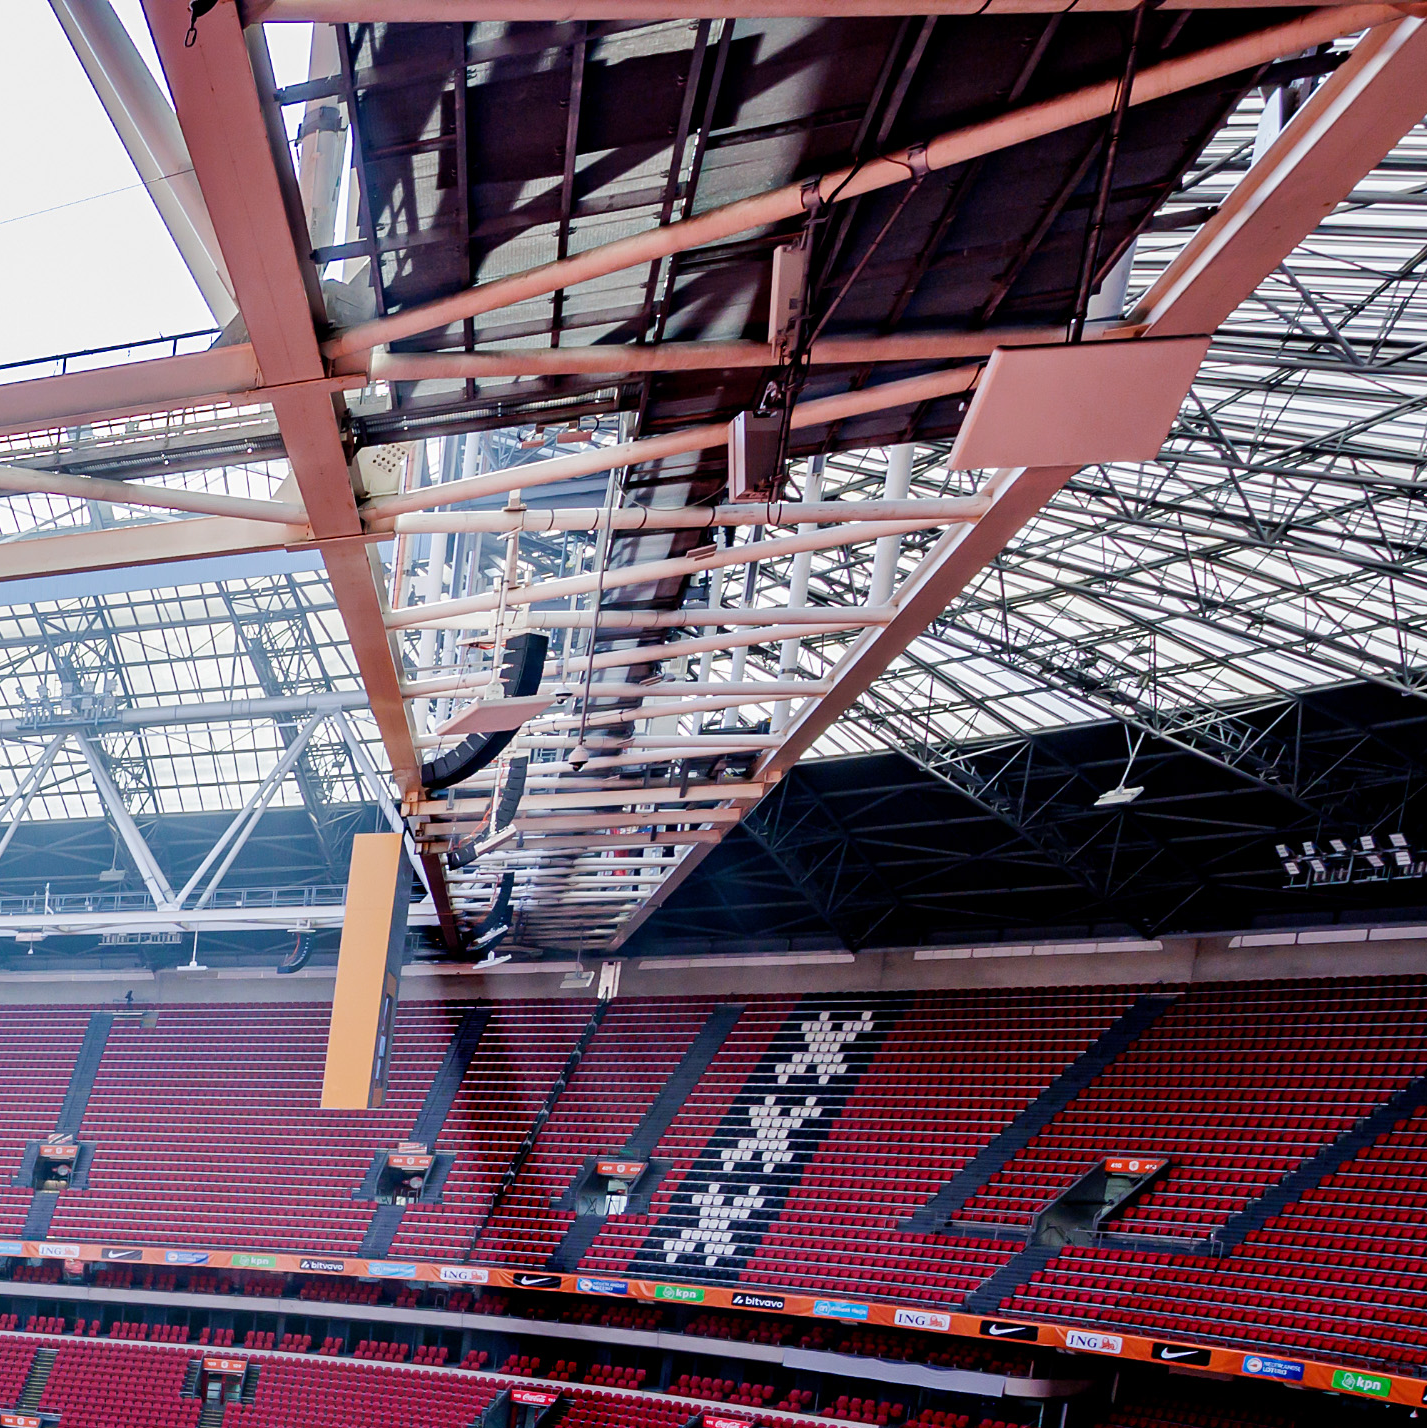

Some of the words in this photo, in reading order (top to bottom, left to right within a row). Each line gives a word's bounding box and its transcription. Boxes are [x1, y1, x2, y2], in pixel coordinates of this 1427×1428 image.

[40, 1246, 62, 1255] ING
[251, 1257, 269, 1266] kpn
[311, 1261, 344, 1271] bitvavo
[676, 1288, 696, 1299] kpn
[745, 1296, 783, 1308] bitvavo
[898, 1313, 925, 1326] ING
[1070, 1334, 1097, 1348] ING
[1357, 1376, 1382, 1391] kpn
